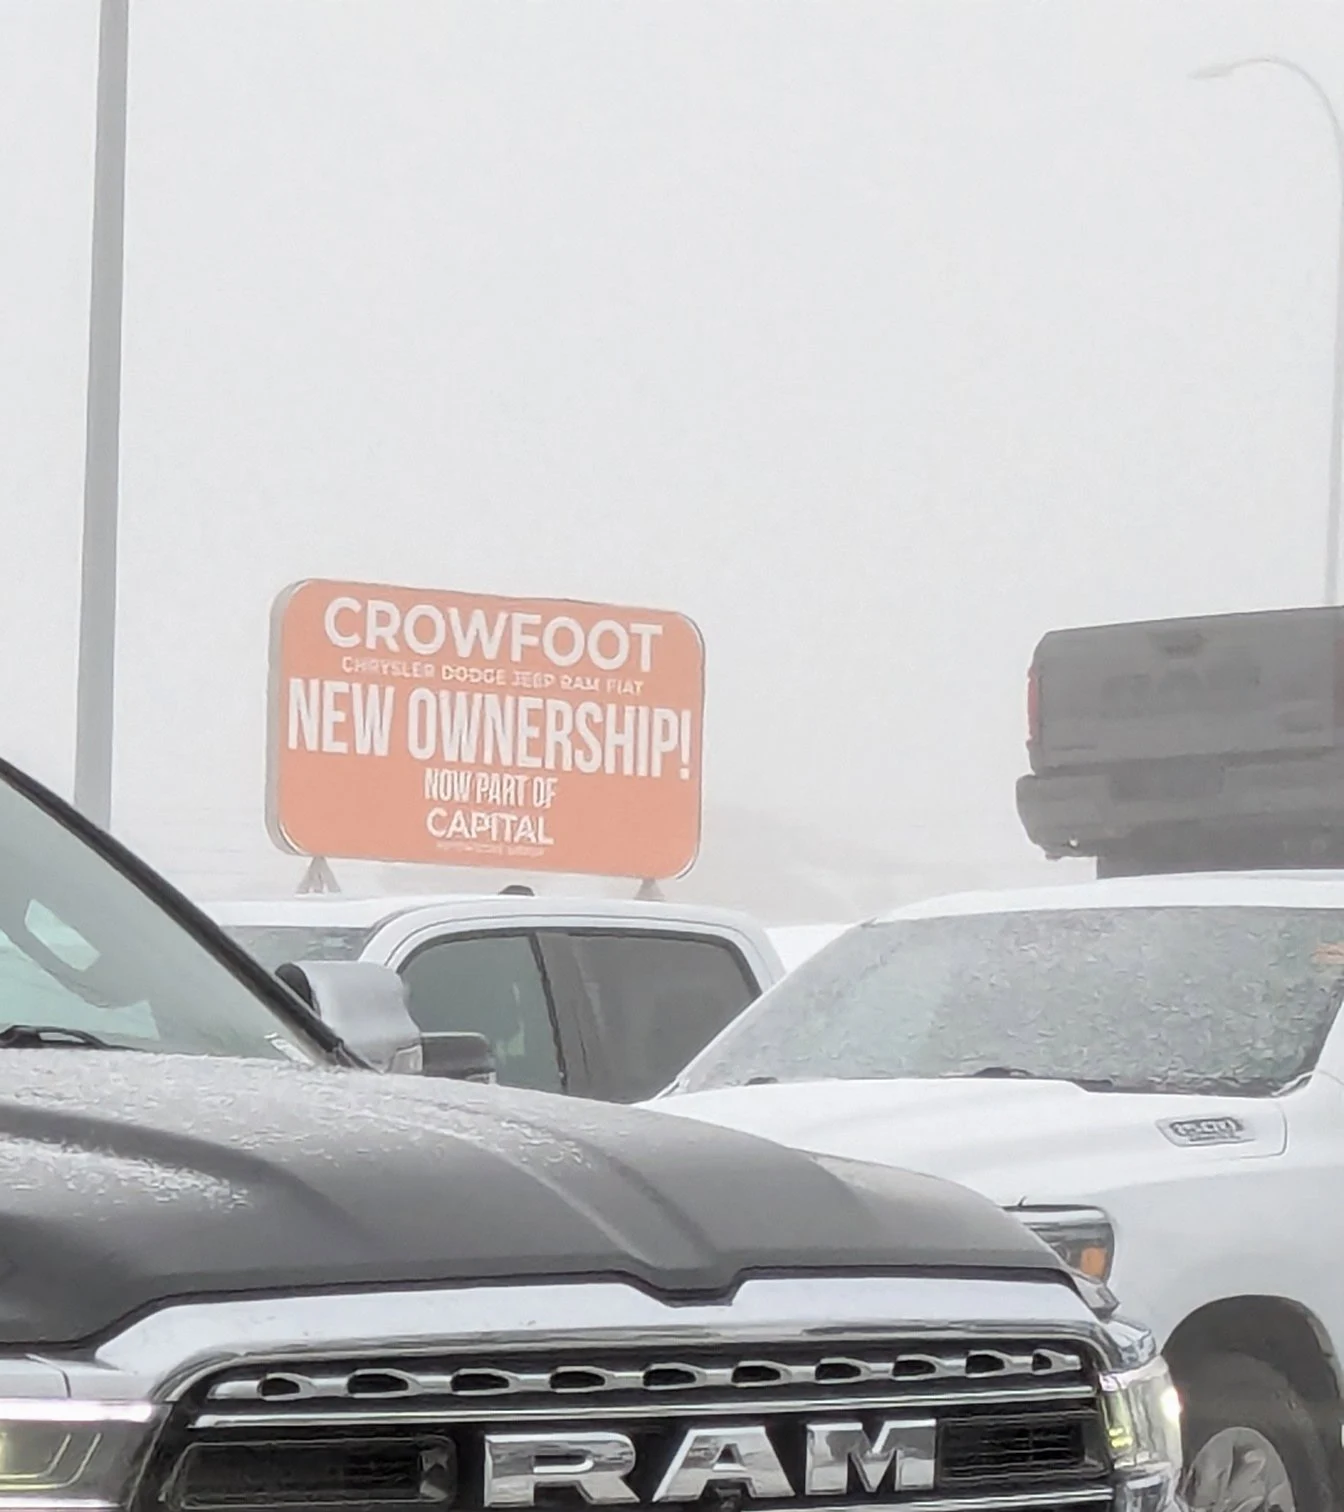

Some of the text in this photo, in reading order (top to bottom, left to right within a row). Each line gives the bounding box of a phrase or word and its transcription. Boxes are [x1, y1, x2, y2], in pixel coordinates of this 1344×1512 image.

[324, 596, 663, 673] CROWFOOT
[341, 656, 435, 679] CHRYSLER
[441, 664, 506, 686] DODGE
[560, 674, 600, 692] RAM
[606, 678, 644, 696] FIAT
[287, 677, 692, 780] NEW OWNERSHIP!
[424, 767, 558, 809] NOW PART OF
[426, 806, 554, 845] CAPITAL
[483, 1418, 937, 1508] RAM
